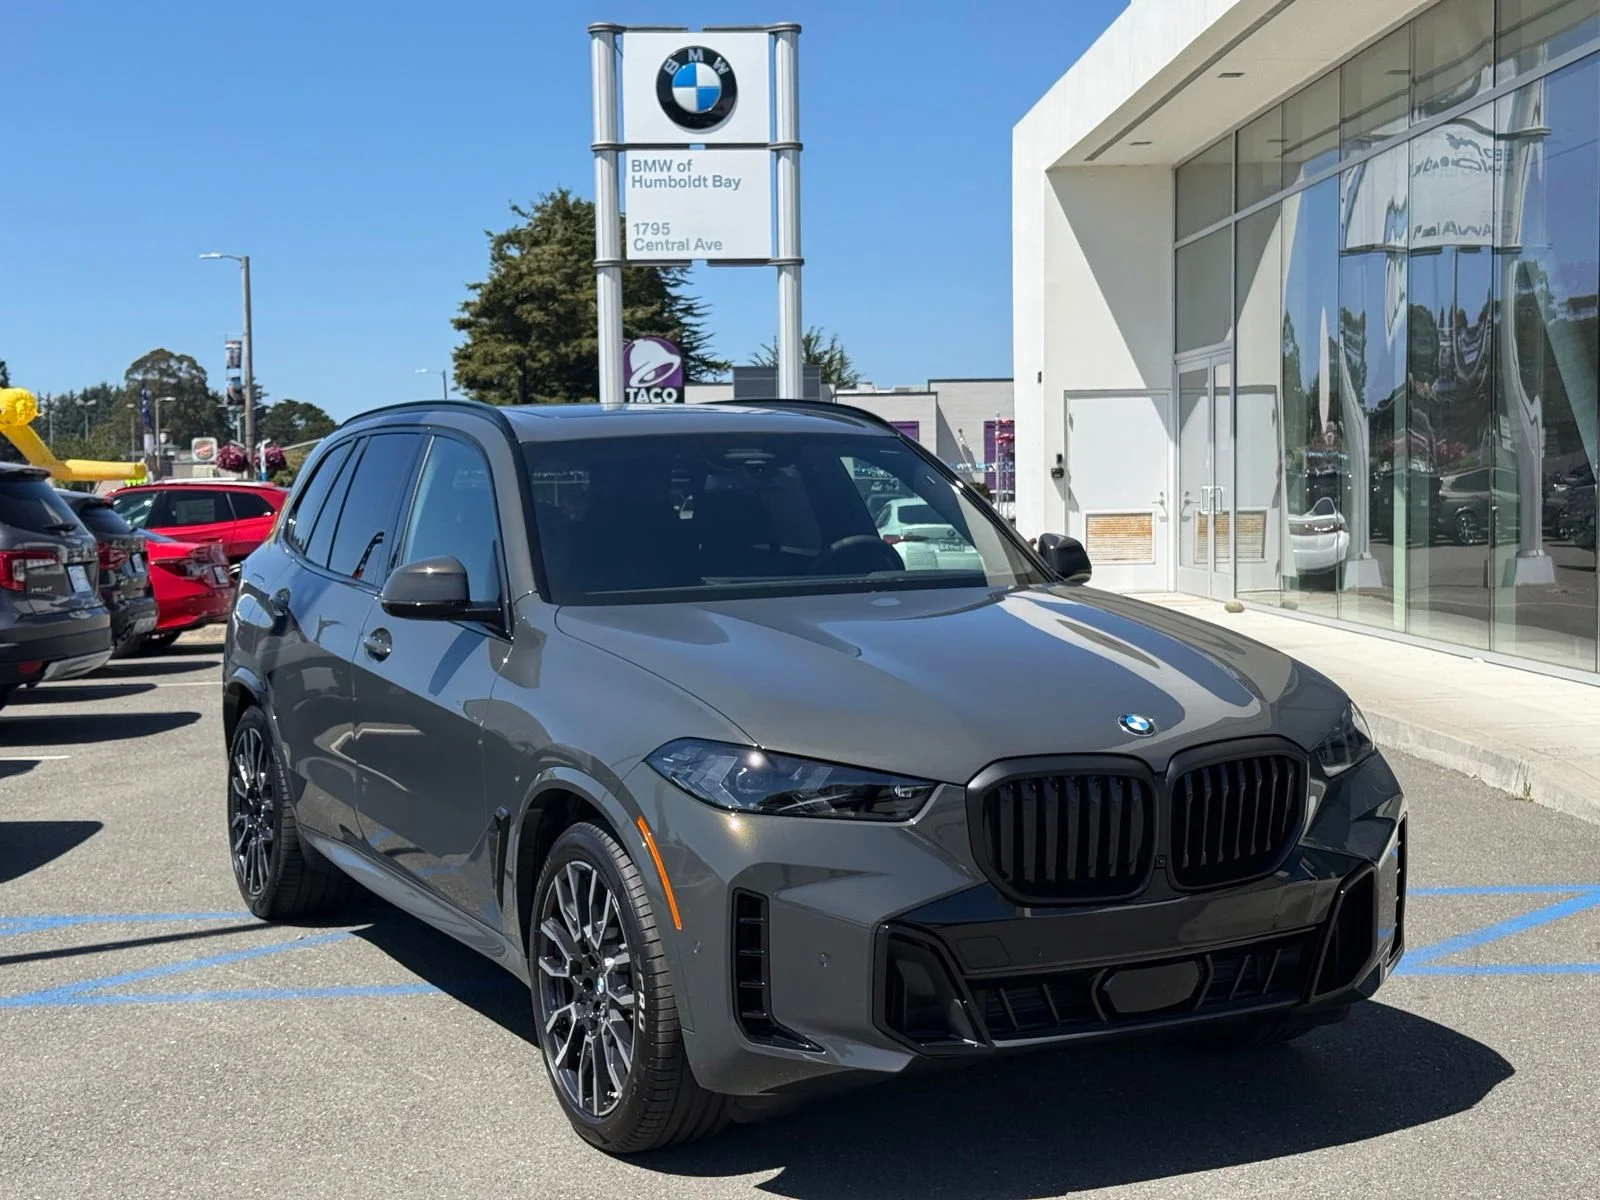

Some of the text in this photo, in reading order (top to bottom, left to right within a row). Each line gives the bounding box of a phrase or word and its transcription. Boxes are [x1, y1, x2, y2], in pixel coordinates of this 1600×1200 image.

[663, 48, 730, 76] BMW
[631, 159, 693, 173] BMW of
[631, 174, 742, 192] Humboldt Bay
[633, 222, 671, 236] 1795
[633, 238, 723, 252] Central Ave
[625, 387, 678, 403] TACO
